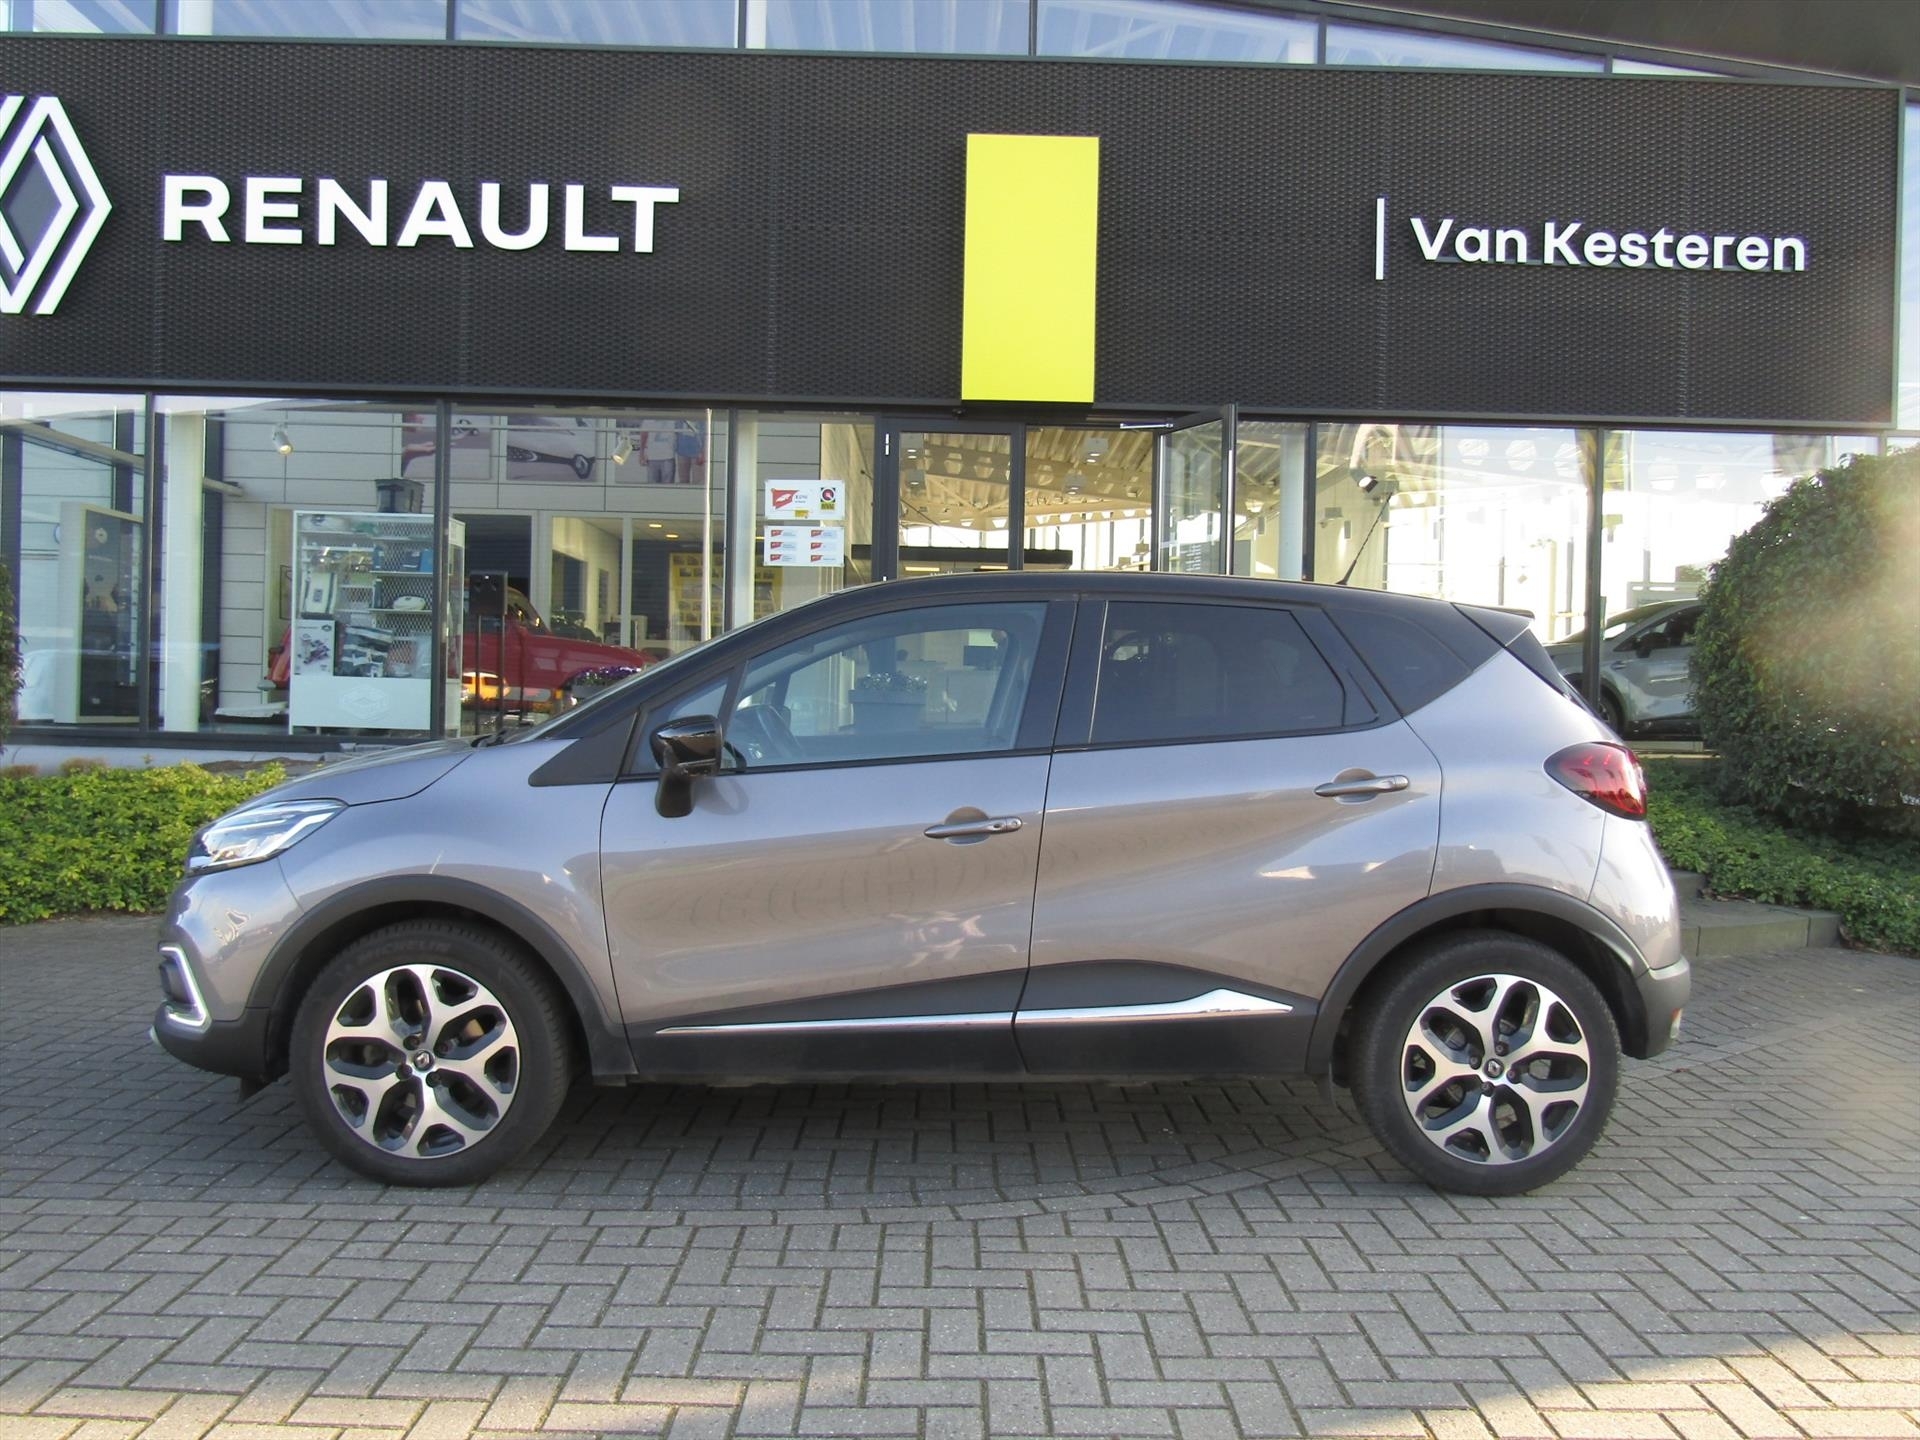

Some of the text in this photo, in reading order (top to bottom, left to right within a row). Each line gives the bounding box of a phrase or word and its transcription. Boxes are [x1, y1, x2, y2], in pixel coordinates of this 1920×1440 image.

[163, 174, 680, 253] RENAULT
[1409, 217, 1807, 272] Van Kesteren
